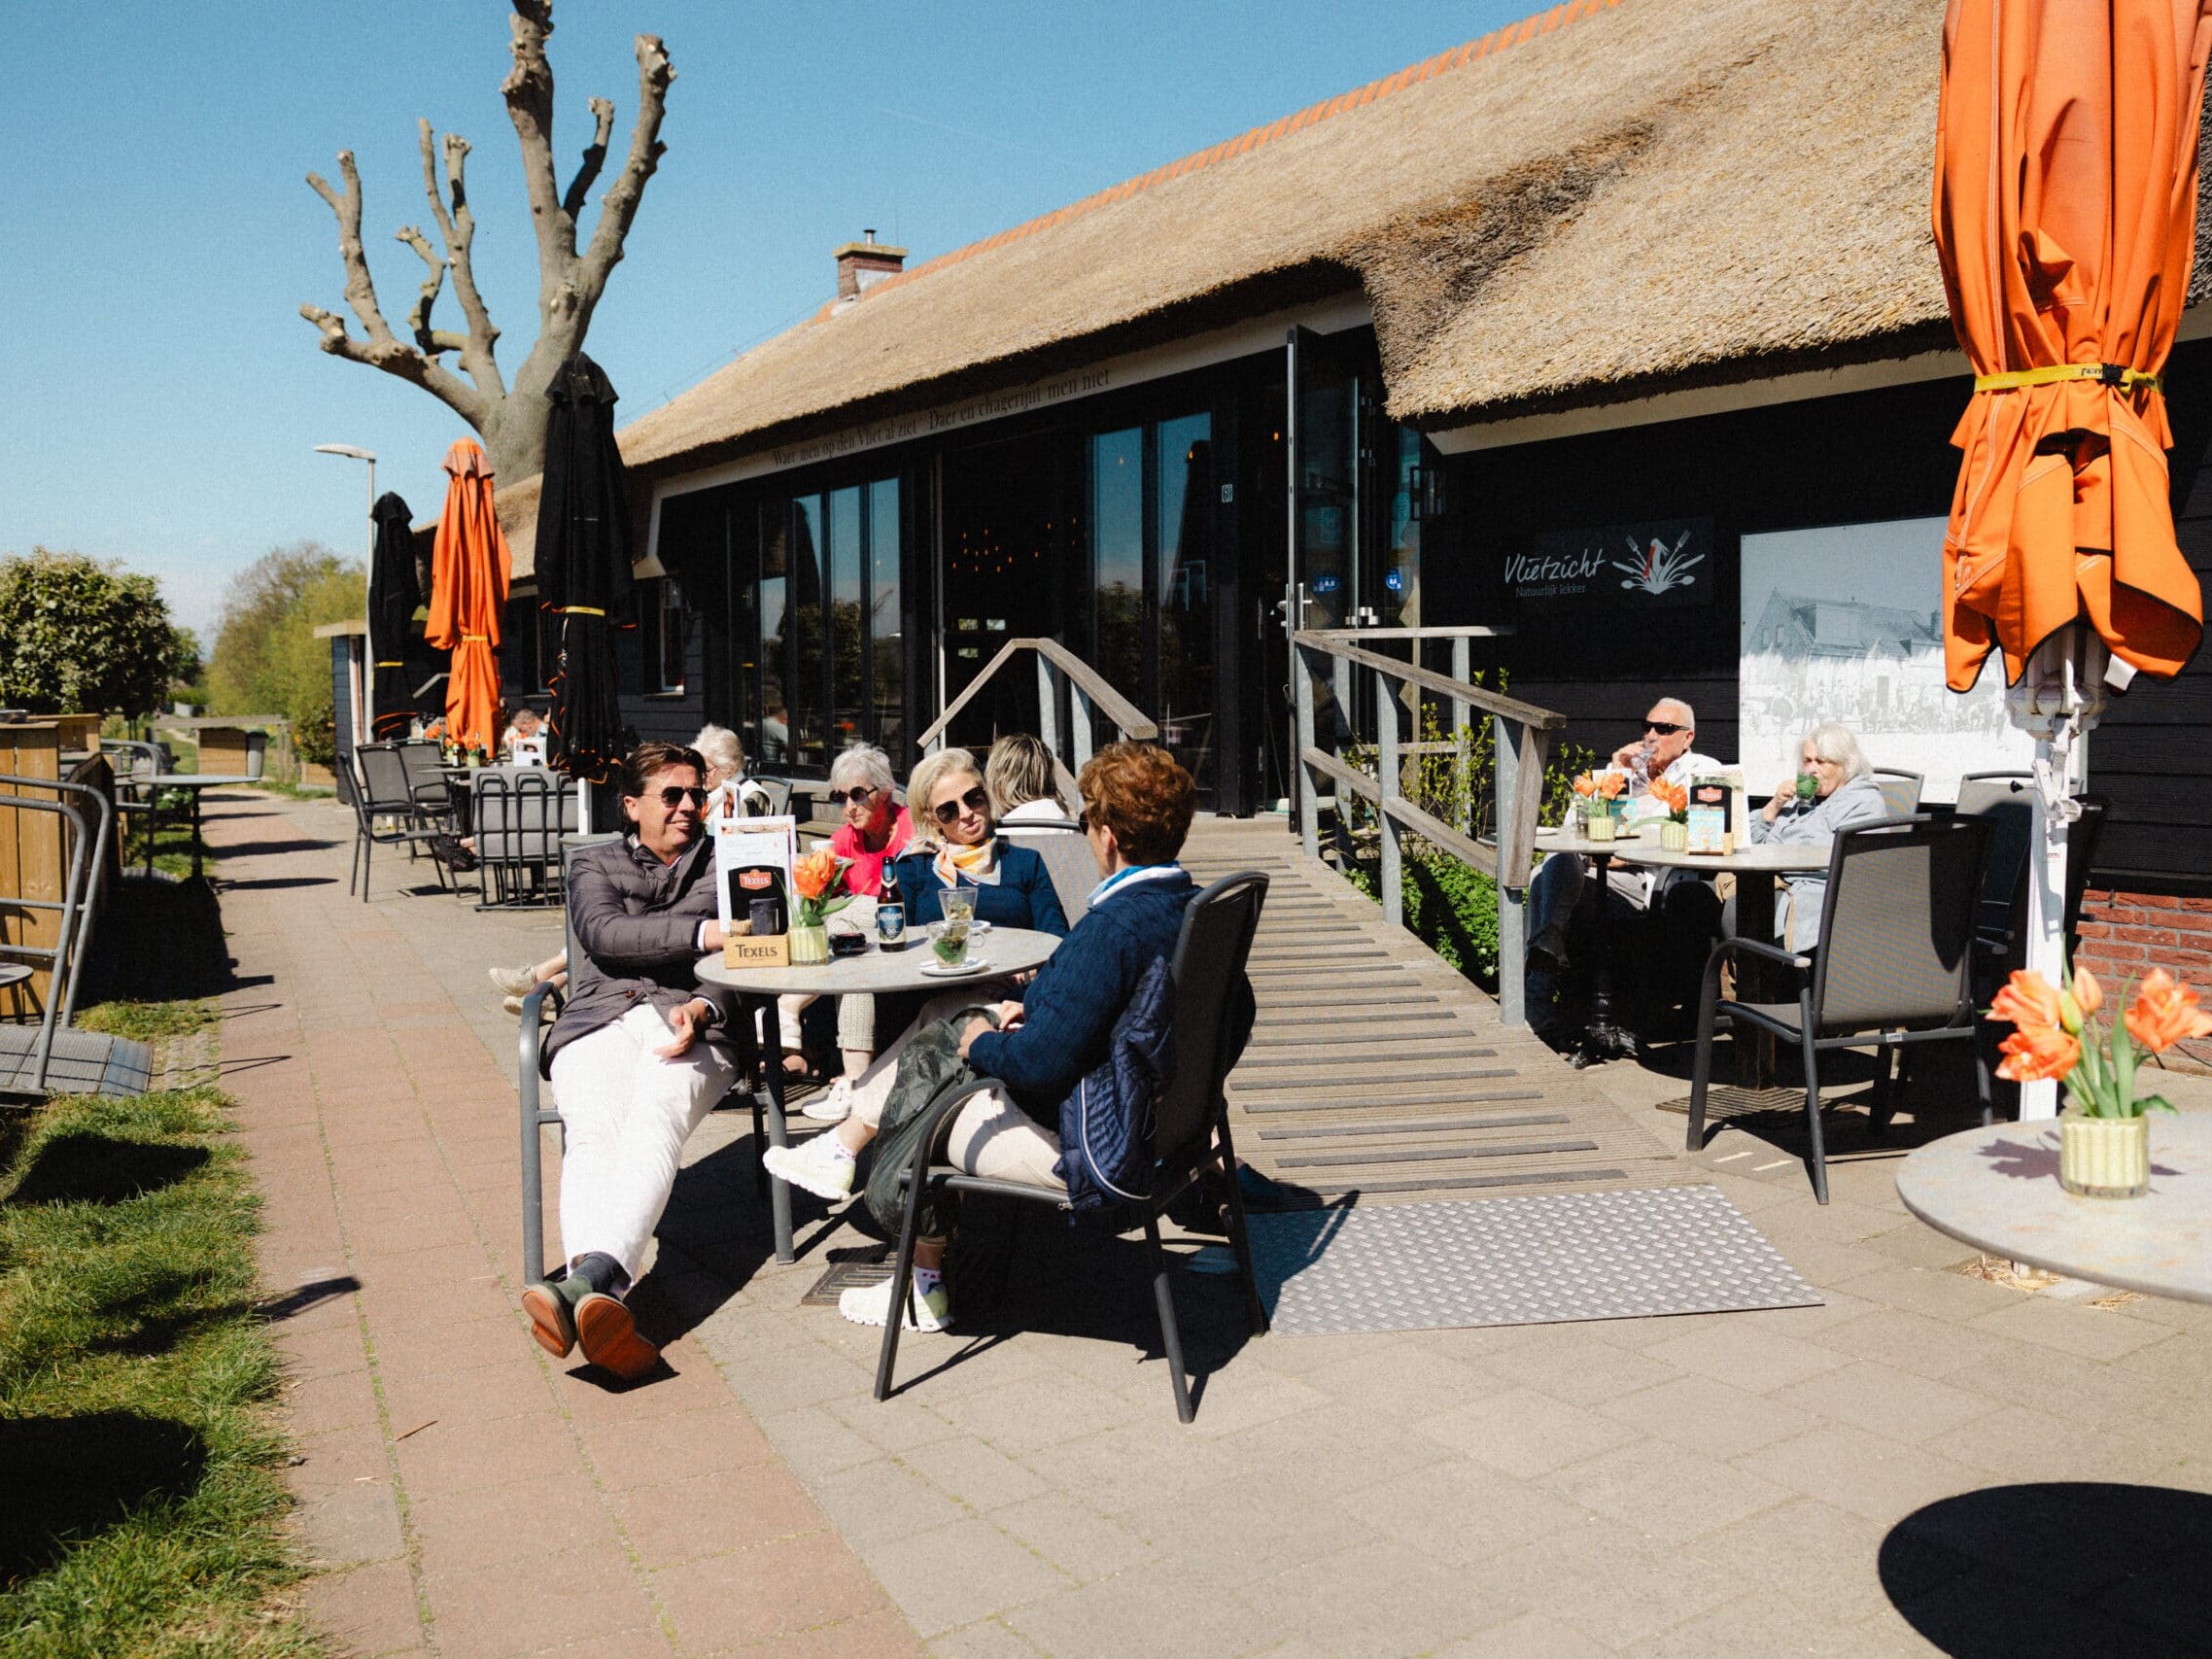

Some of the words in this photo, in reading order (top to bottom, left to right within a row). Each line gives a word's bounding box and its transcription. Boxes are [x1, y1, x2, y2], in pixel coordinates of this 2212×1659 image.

[773, 449, 796, 466] Waer
[800, 443, 820, 462] men
[823, 442, 835, 459] op
[838, 433, 855, 451] den
[858, 428, 881, 446] Vliet
[885, 420, 895, 439] al
[898, 419, 917, 437] ziet
[929, 408, 956, 429] Daer
[961, 403, 975, 422] en
[1049, 379, 1077, 398] men
[1083, 367, 1108, 390] niet
[1504, 547, 1607, 584] Vlietzicht
[735, 944, 778, 958] TEXELS
